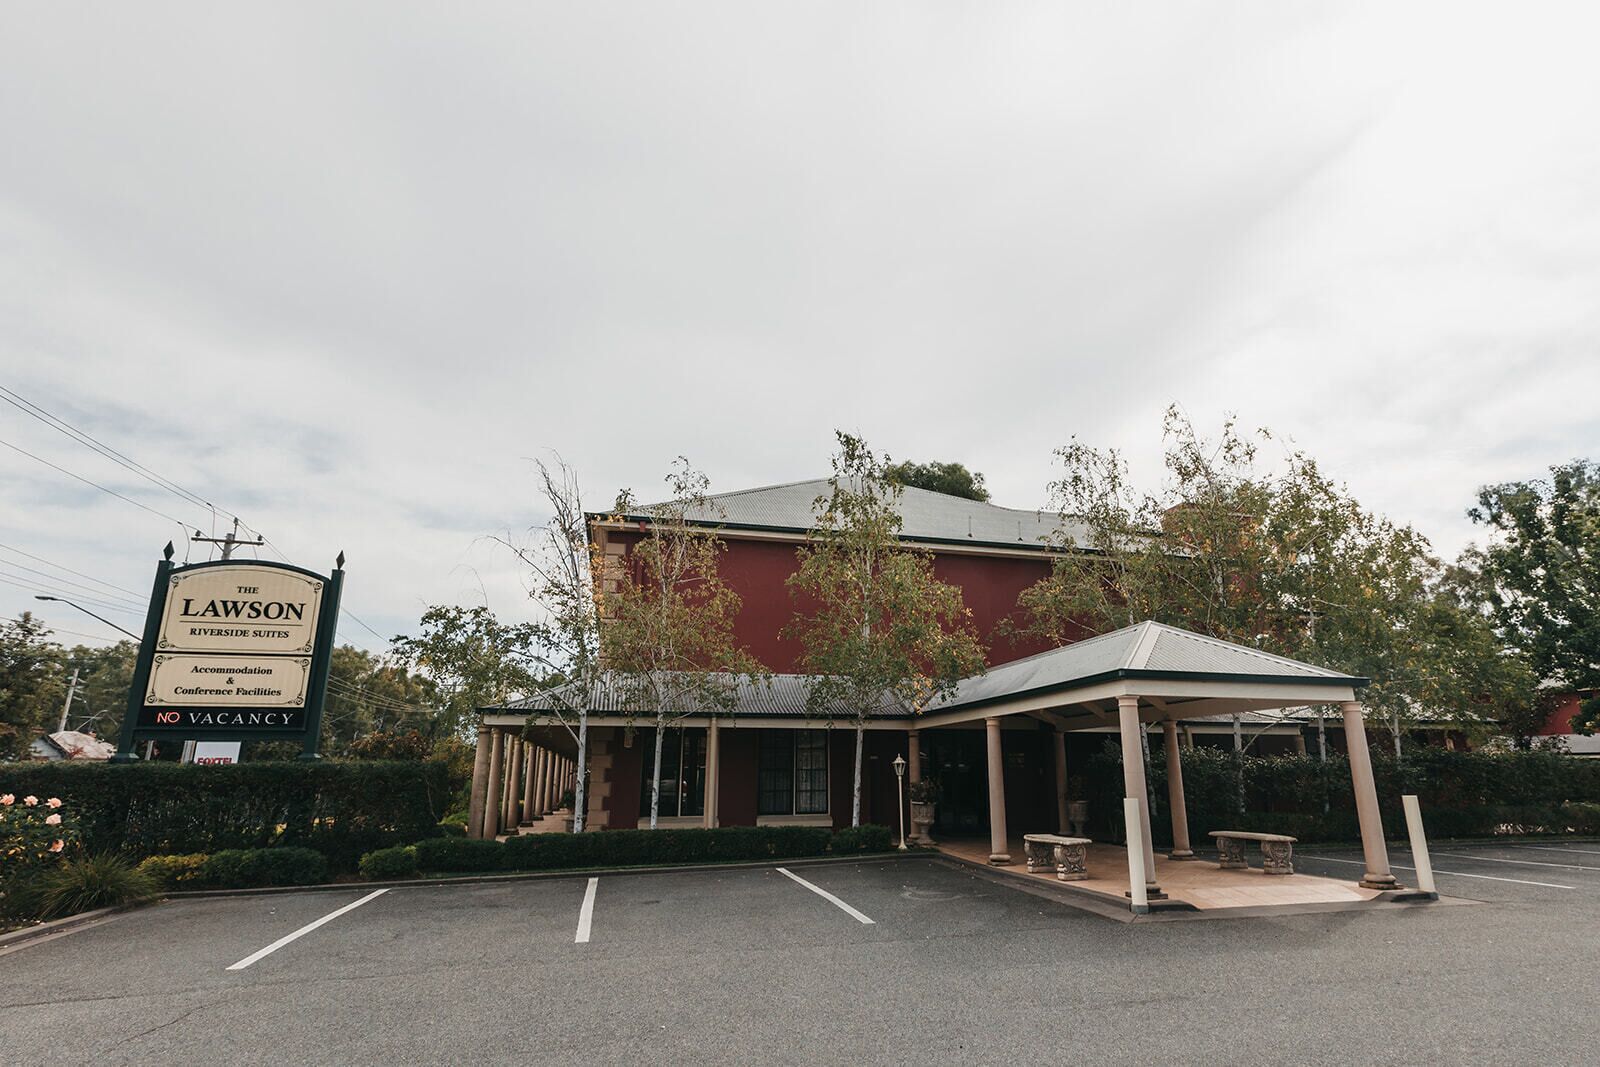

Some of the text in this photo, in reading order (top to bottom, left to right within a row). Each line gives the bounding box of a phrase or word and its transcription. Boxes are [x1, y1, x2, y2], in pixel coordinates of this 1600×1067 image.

[237, 586, 259, 594] THE
[180, 598, 306, 620] LAWSON
[189, 627, 289, 638] RIVERSIDE SUITES
[191, 666, 273, 675] Accommodation
[226, 677, 234, 685] &
[174, 686, 281, 696] Conference Facilities
[156, 711, 293, 725] NO VACANCY
